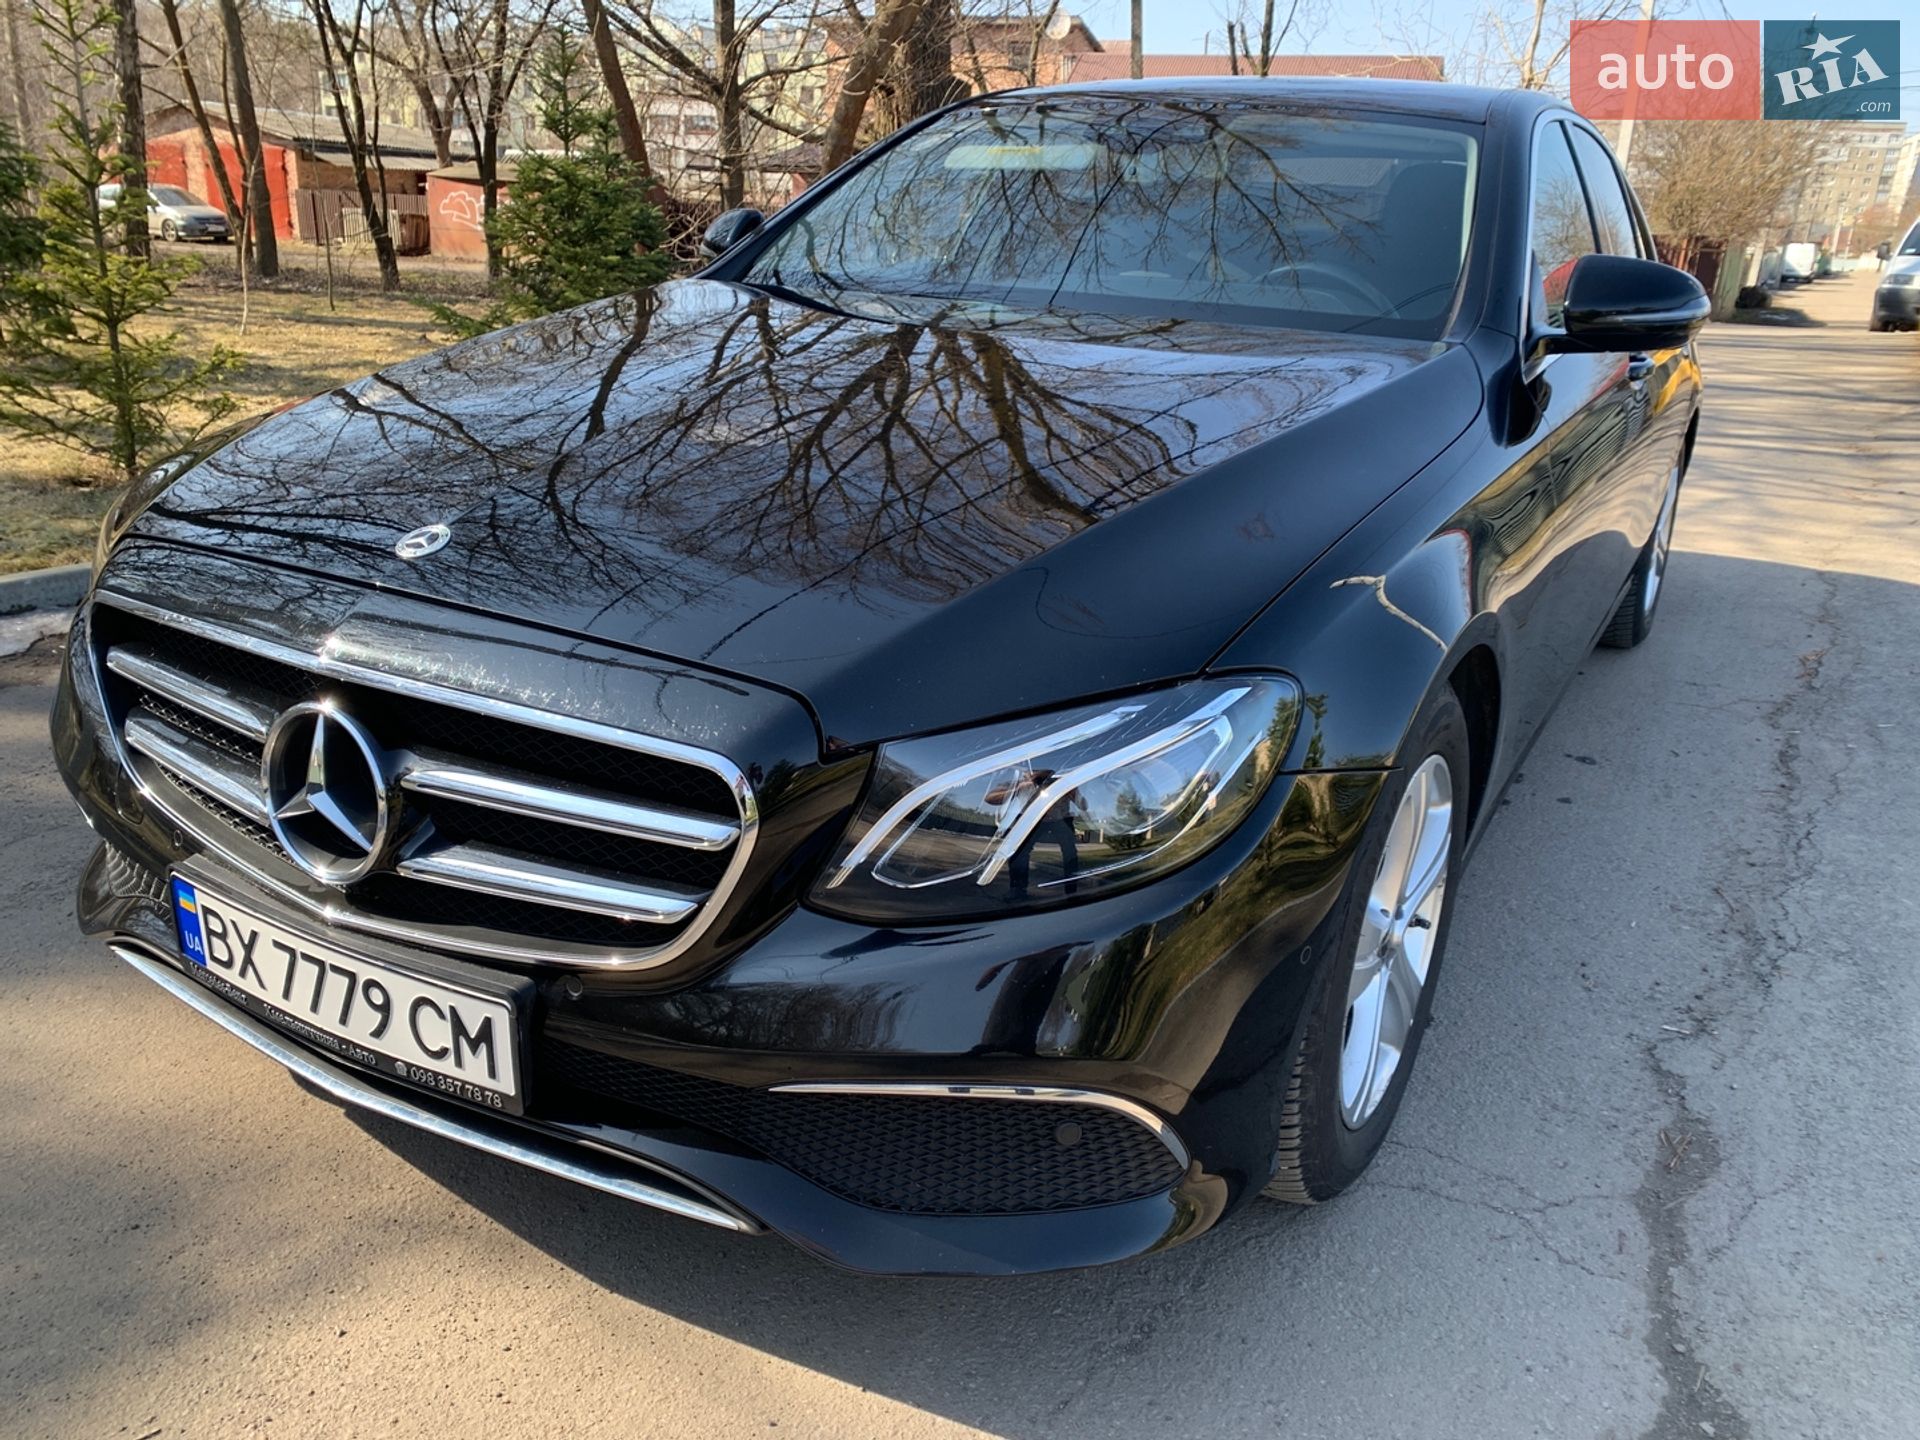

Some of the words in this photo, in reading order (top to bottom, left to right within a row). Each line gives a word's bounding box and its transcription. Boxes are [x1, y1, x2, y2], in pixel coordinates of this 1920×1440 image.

[184, 930, 204, 956] UA
[200, 903, 268, 991] BX
[271, 938, 391, 1039] 7779
[408, 995, 497, 1080] CM
[410, 1066, 436, 1086] 098
[438, 1075, 462, 1095] 357
[464, 1084, 482, 1101] 78
[484, 1091, 502, 1108] 78
